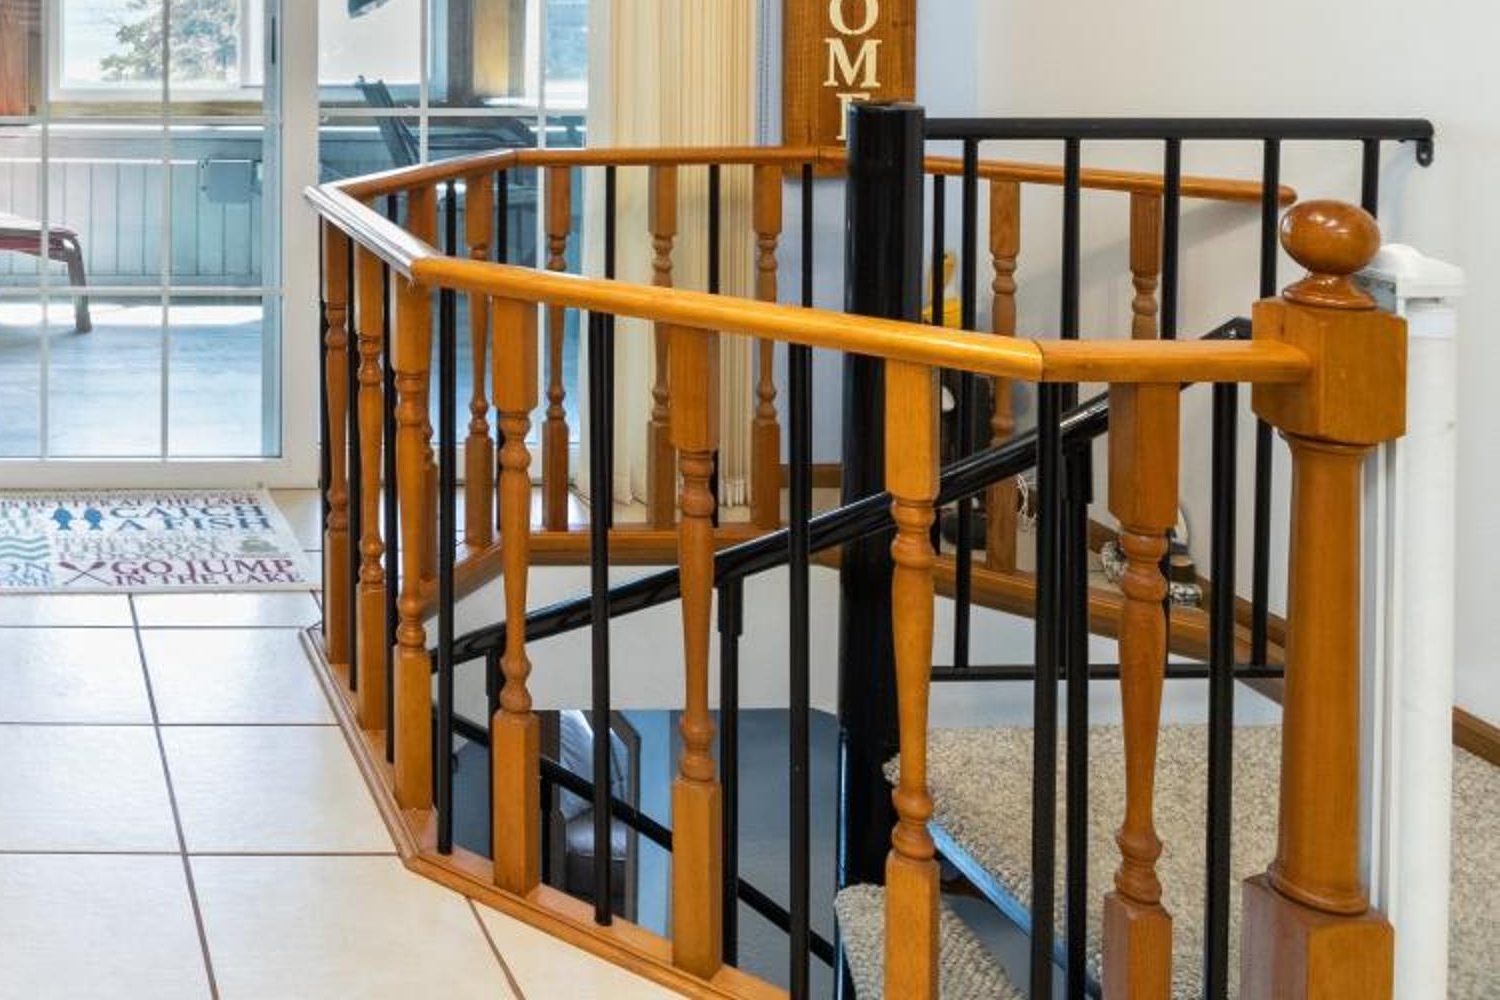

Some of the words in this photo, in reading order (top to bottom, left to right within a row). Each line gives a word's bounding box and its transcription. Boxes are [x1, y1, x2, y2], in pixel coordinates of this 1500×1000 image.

[110, 505, 265, 518] CATCH
[116, 519, 147, 531] A
[163, 518, 273, 531] FISH
[111, 560, 173, 575] GO
[184, 559, 294, 576] JUMP
[115, 574, 147, 585] IN
[153, 574, 220, 585] THE
[222, 572, 305, 585] LAKE
